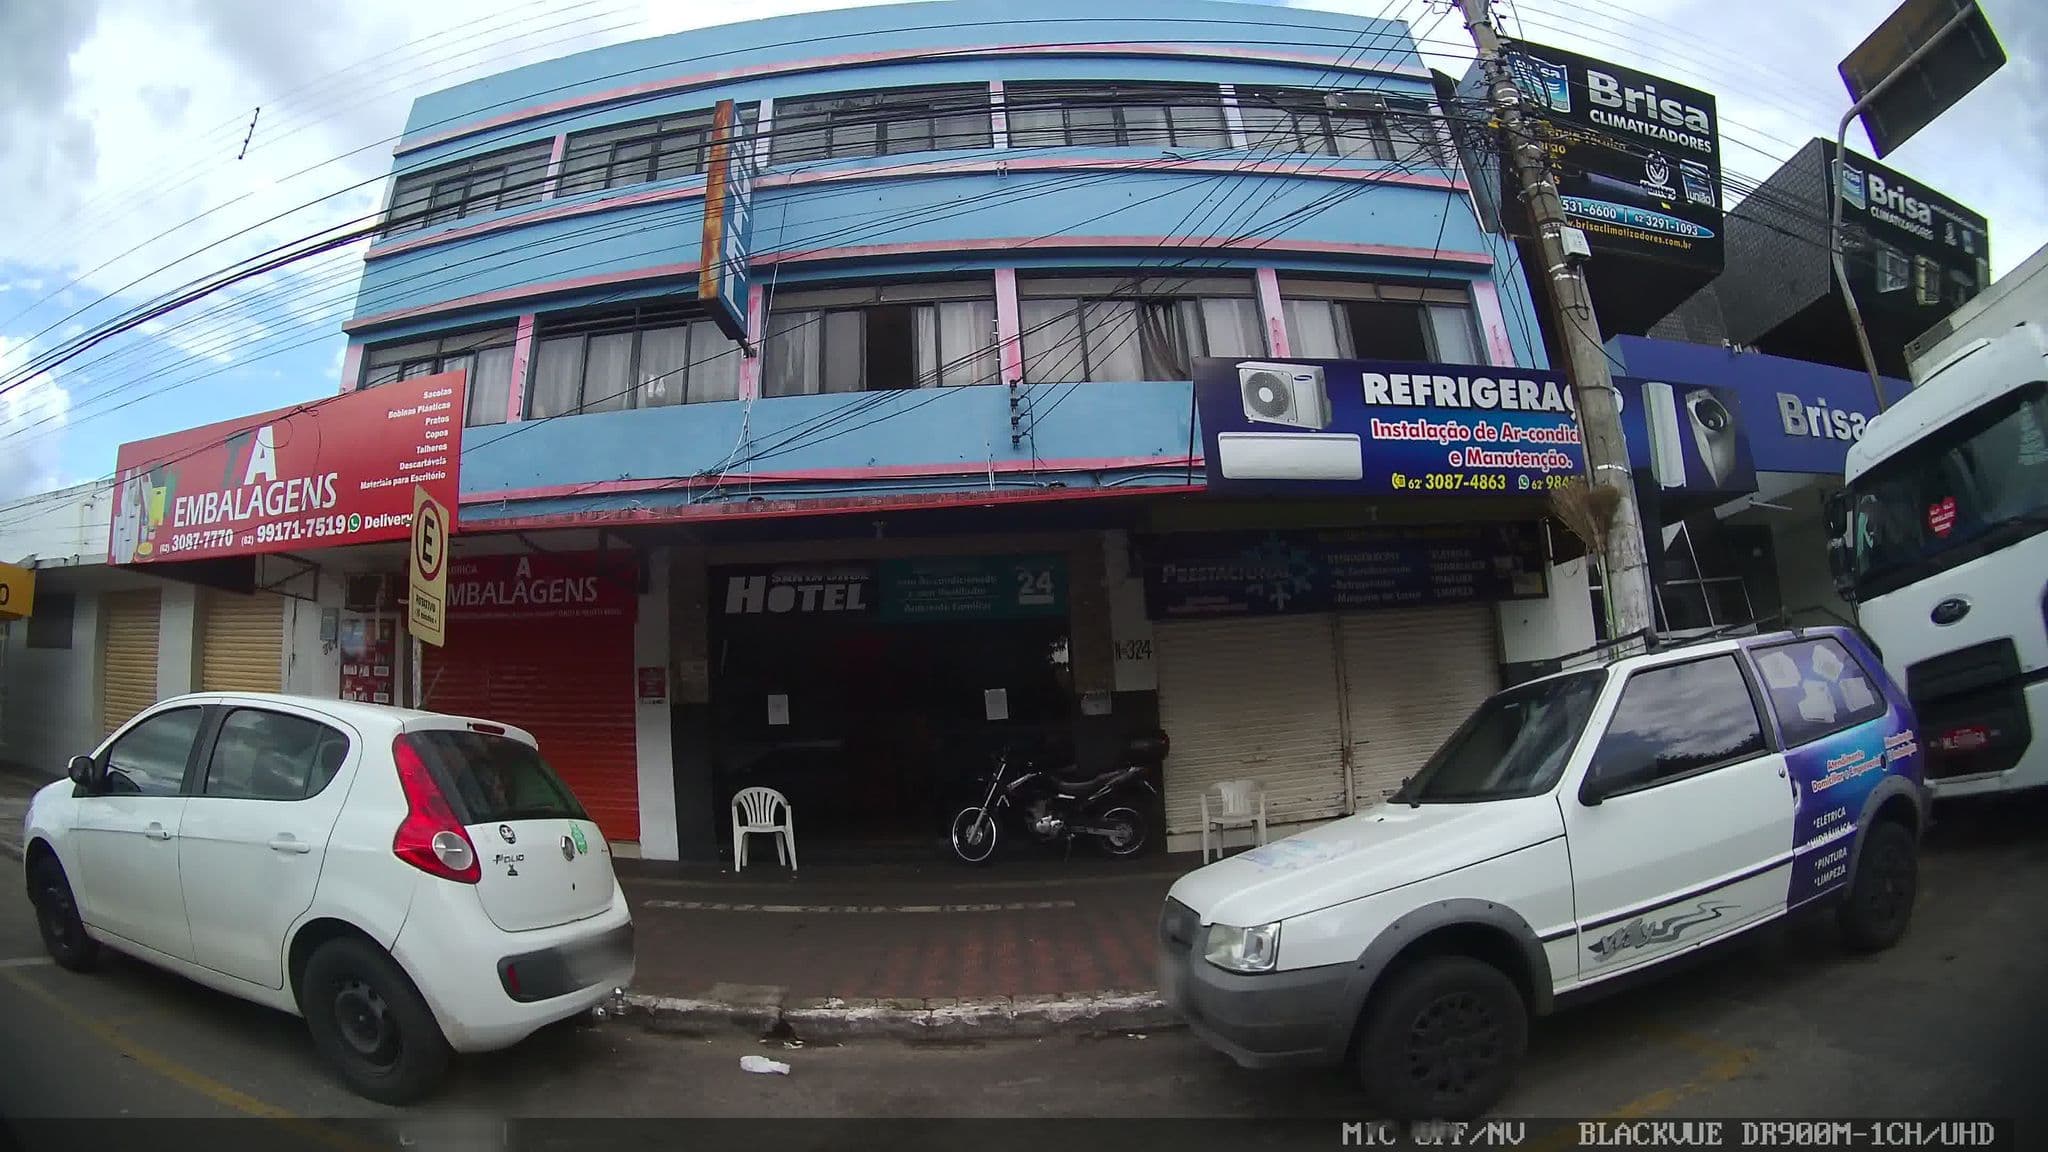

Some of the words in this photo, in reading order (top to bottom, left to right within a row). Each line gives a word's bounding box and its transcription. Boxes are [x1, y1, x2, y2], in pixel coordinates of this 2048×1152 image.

[1587, 69, 1711, 136] Brisa
[1589, 109, 1712, 154] CLIMATIZADORES
[1868, 173, 1932, 226] Brisa
[1561, 200, 1617, 219] 531-6600
[1645, 214, 1698, 236] 3291-1093
[423, 387, 453, 399] Sacolas
[1362, 373, 1578, 420] REFRIGERAÇ
[388, 407, 416, 419] Bobinas
[417, 401, 451, 414] Plásticas
[425, 415, 450, 426] Pratos
[1775, 391, 1867, 441] Brisa
[425, 429, 449, 439] Copos
[1371, 418, 1471, 445] Instalação
[1473, 418, 1498, 441] de
[1500, 423, 1582, 445] Ar-condici
[416, 442, 448, 454] Talheres
[1449, 450, 1462, 467] e
[1465, 447, 1574, 472] Manutenção.
[399, 456, 447, 470] Descartáveis
[360, 477, 392, 490] Materiais
[392, 476, 410, 486] para
[410, 470, 446, 483] Escritório
[1425, 473, 1506, 490] 3087-4863
[174, 472, 338, 528] EMBALAGENS
[171, 528, 234, 552] 3087-7770
[256, 514, 346, 543] 99171-7519
[364, 513, 413, 529] Delivery
[422, 514, 435, 565] E
[446, 577, 599, 607] MBALAGENS
[725, 575, 867, 614] HOTEL
[1017, 568, 1056, 594] 24
